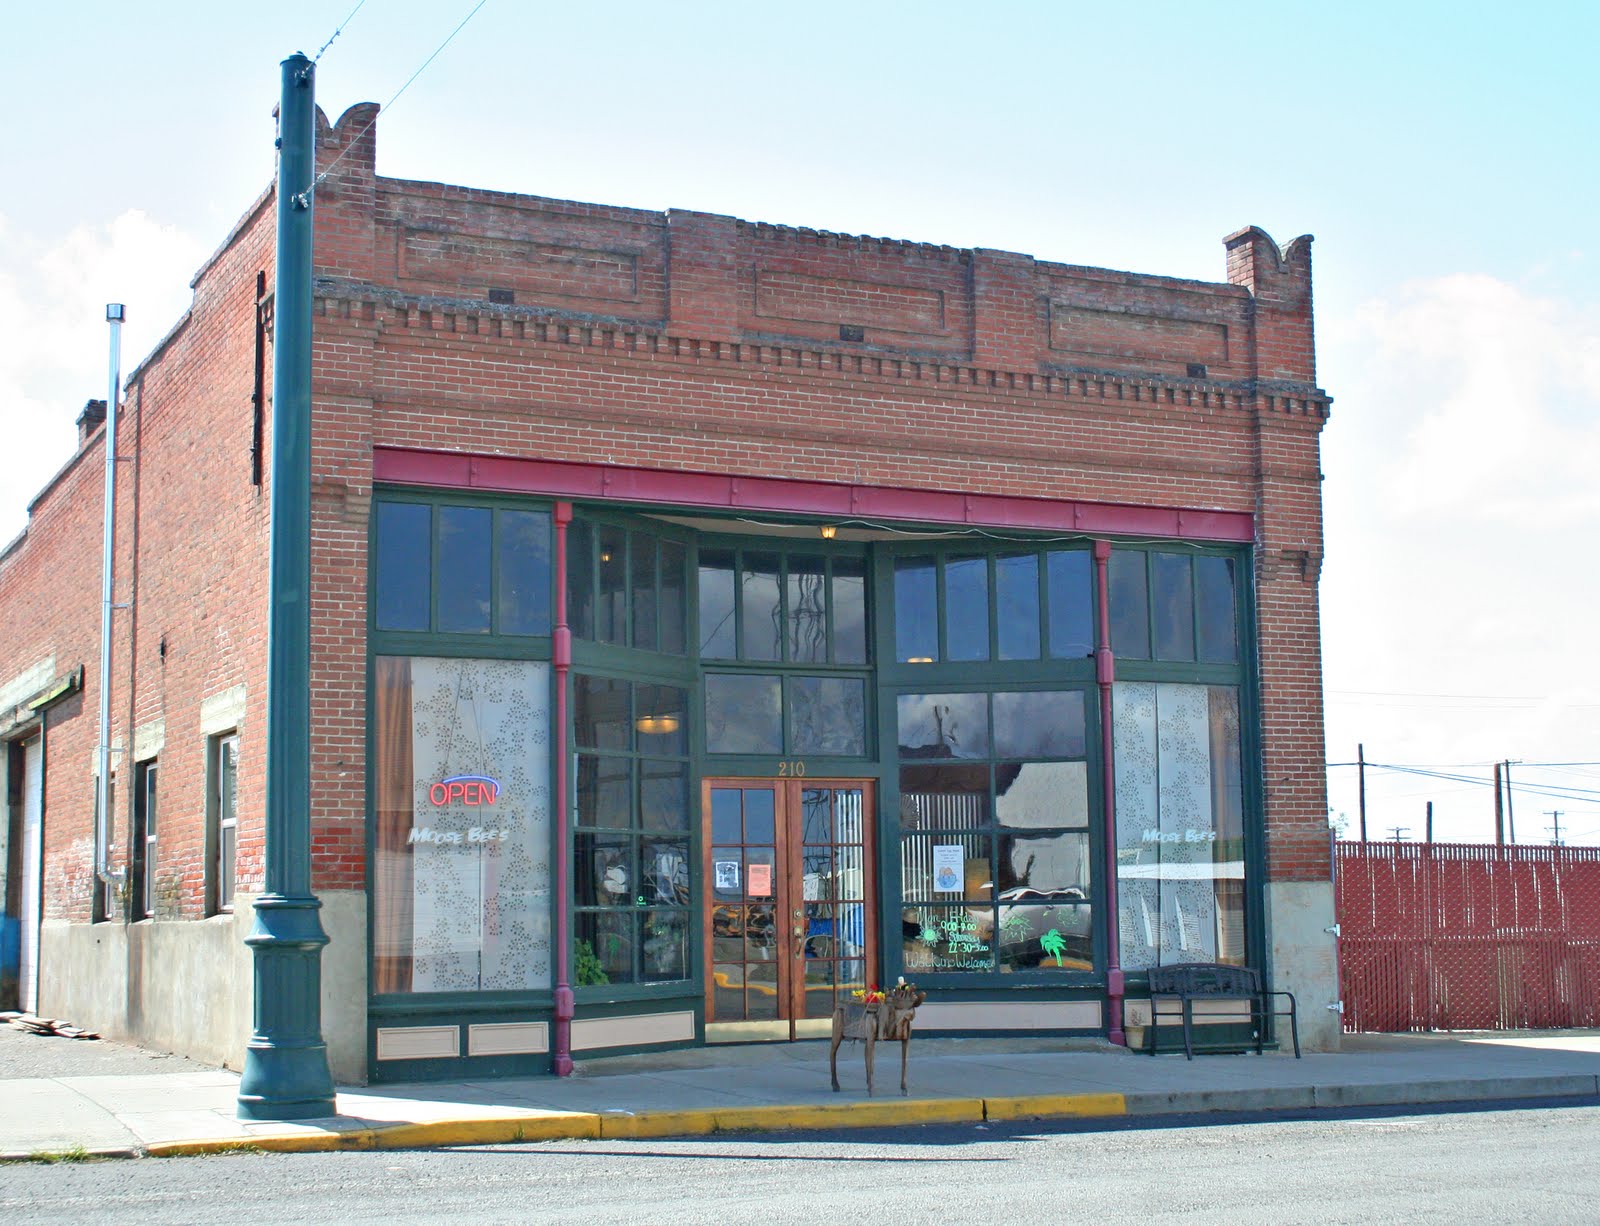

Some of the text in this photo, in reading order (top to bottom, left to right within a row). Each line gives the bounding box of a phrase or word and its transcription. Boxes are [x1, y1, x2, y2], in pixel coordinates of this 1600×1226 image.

[778, 761, 806, 777] 210
[430, 783, 496, 806] OPEN
[408, 827, 464, 845] MOOSE
[1142, 828, 1181, 844] MOOSE
